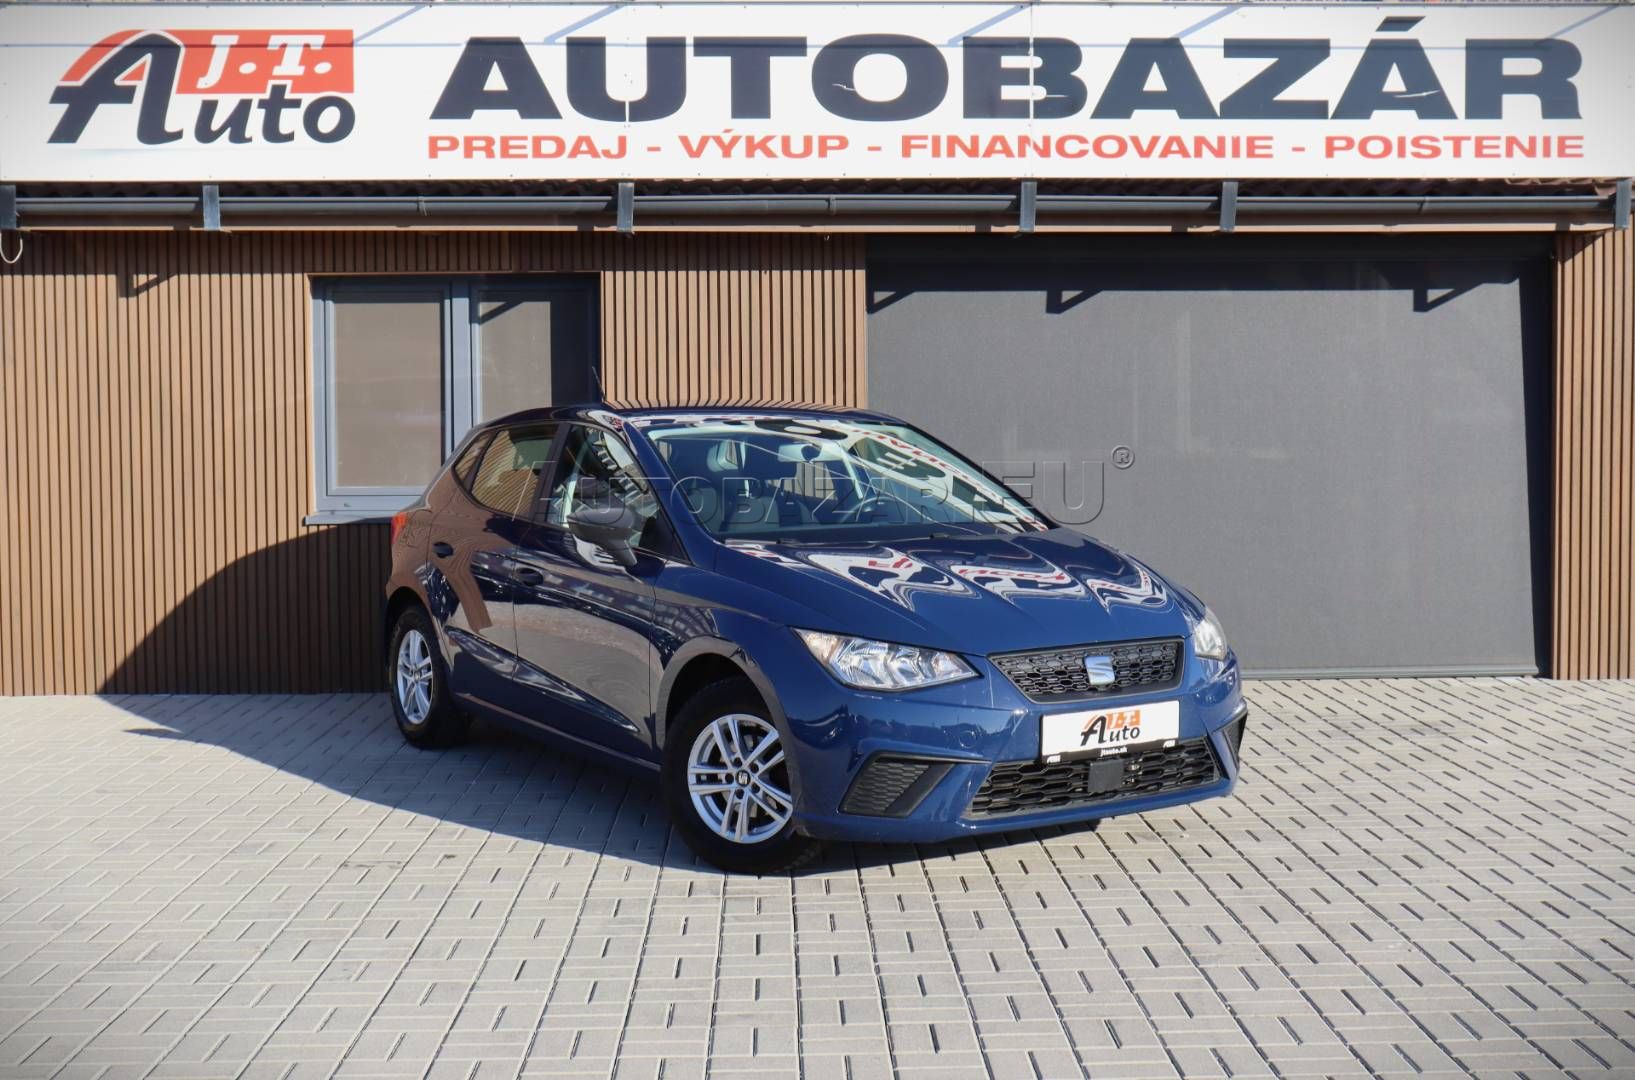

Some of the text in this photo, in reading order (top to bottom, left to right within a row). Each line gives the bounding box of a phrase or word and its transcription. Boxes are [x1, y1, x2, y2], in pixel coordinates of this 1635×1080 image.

[47, 33, 356, 145] Auto
[429, 16, 1583, 122] AUTOBAZÁR
[427, 134, 628, 159] PREDAJ
[679, 129, 849, 159] VÝKUP
[901, 134, 1273, 159] FINANCOVANIE
[1324, 135, 1585, 159] POISTENIE
[1080, 715, 1140, 746] Auto
